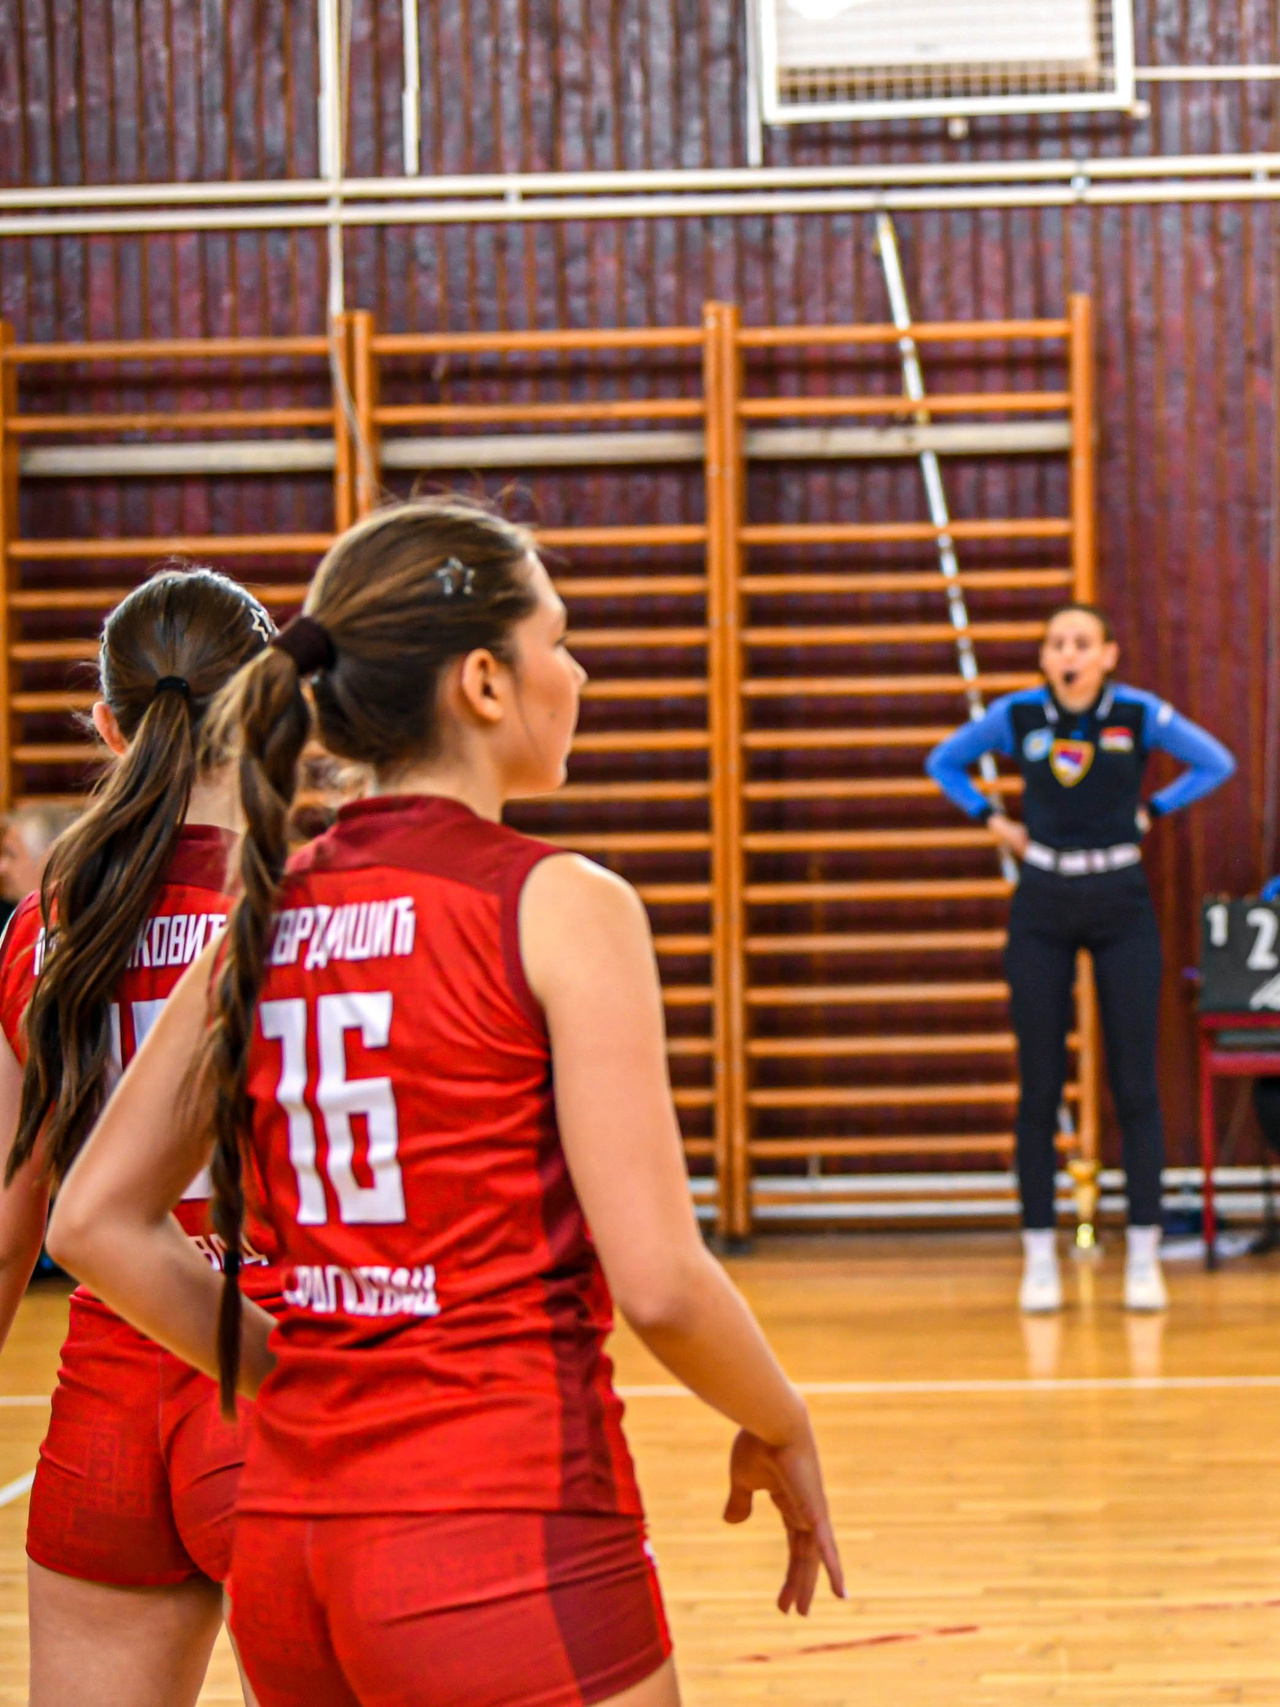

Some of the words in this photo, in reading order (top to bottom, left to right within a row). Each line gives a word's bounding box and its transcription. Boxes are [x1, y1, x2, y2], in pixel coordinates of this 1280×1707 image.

[269, 896, 416, 971] ВРДИШИЋ
[1206, 904, 1229, 948] 1
[1246, 907, 1279, 970] 2
[260, 991, 406, 1225] 16
